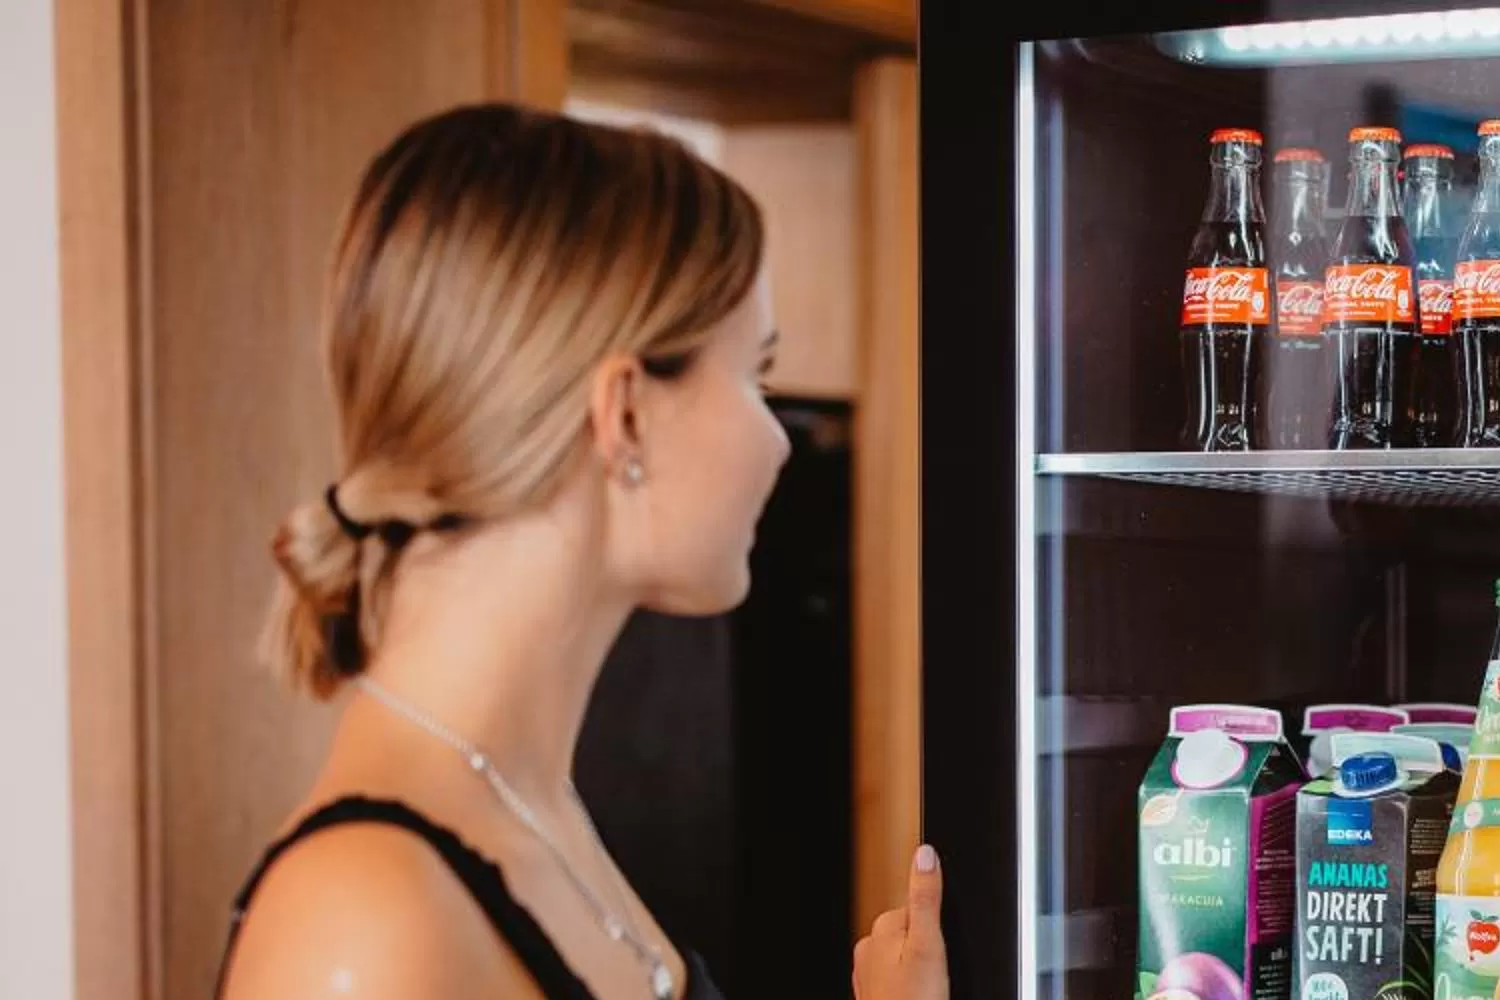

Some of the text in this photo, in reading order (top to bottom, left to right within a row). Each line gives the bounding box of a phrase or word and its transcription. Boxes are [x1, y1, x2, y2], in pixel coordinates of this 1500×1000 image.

[1153, 837, 1232, 869] albi
[1308, 861, 1389, 889] ANANAS
[1306, 891, 1388, 923] DIREKT
[1305, 925, 1384, 965] SAFT!
